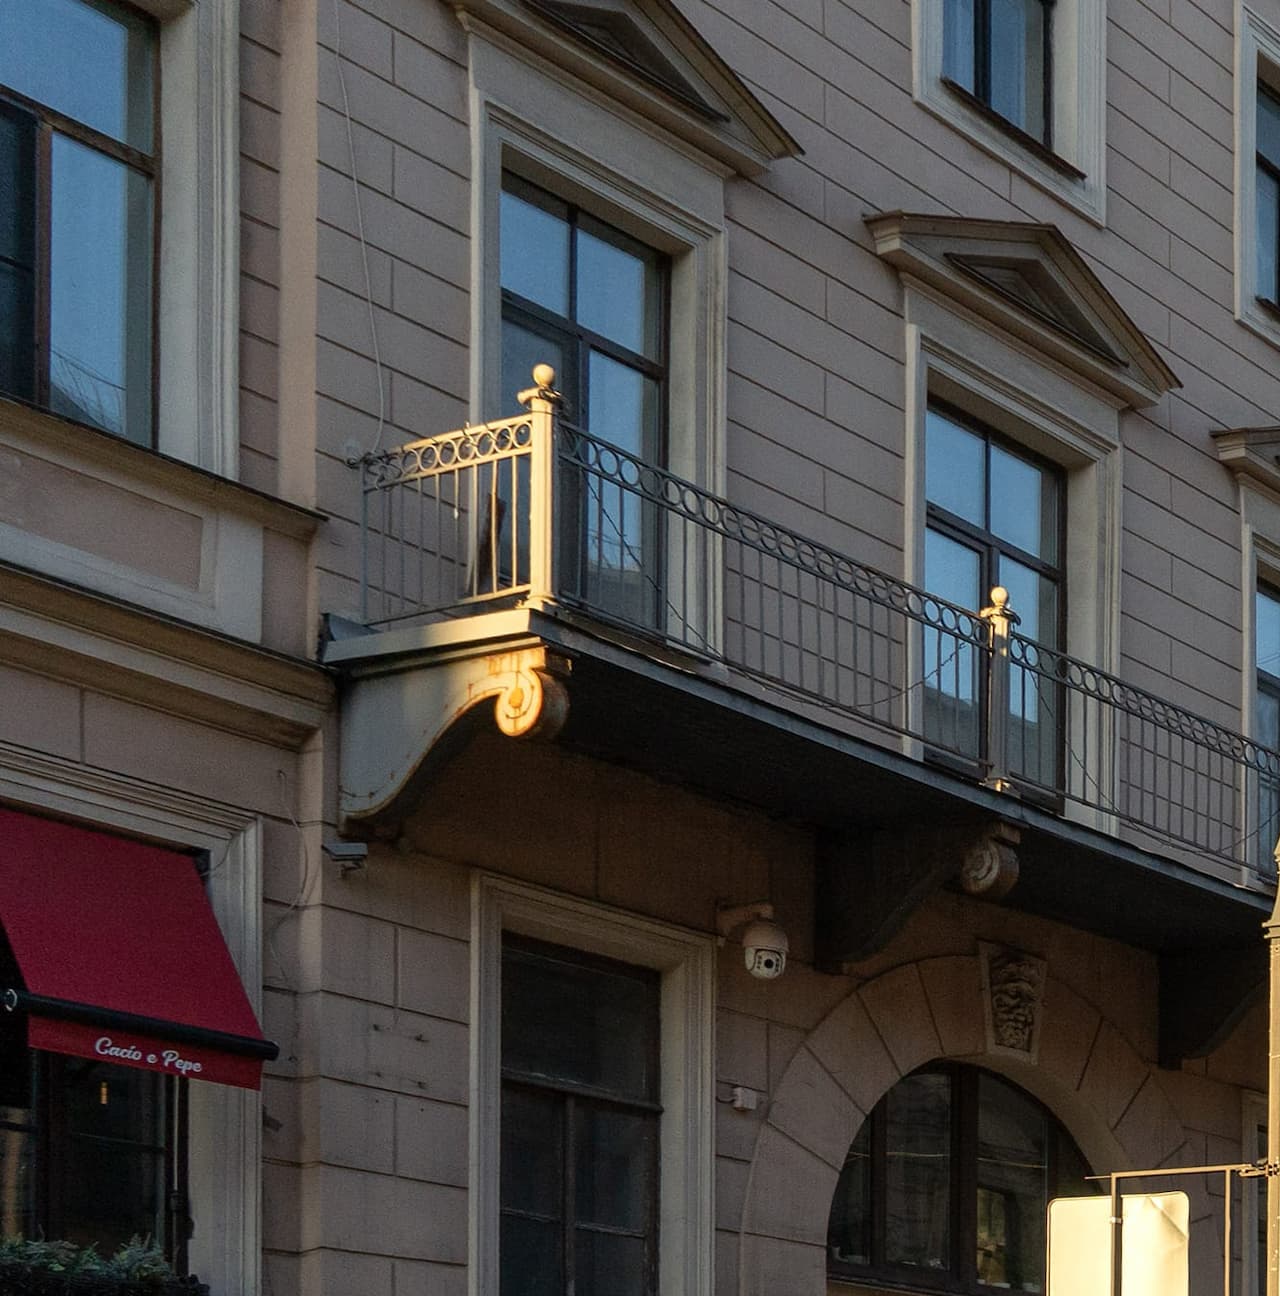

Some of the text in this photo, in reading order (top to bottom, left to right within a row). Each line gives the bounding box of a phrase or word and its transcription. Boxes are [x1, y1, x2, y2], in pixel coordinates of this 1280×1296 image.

[95, 1036, 203, 1074] Cacio e Pepe
